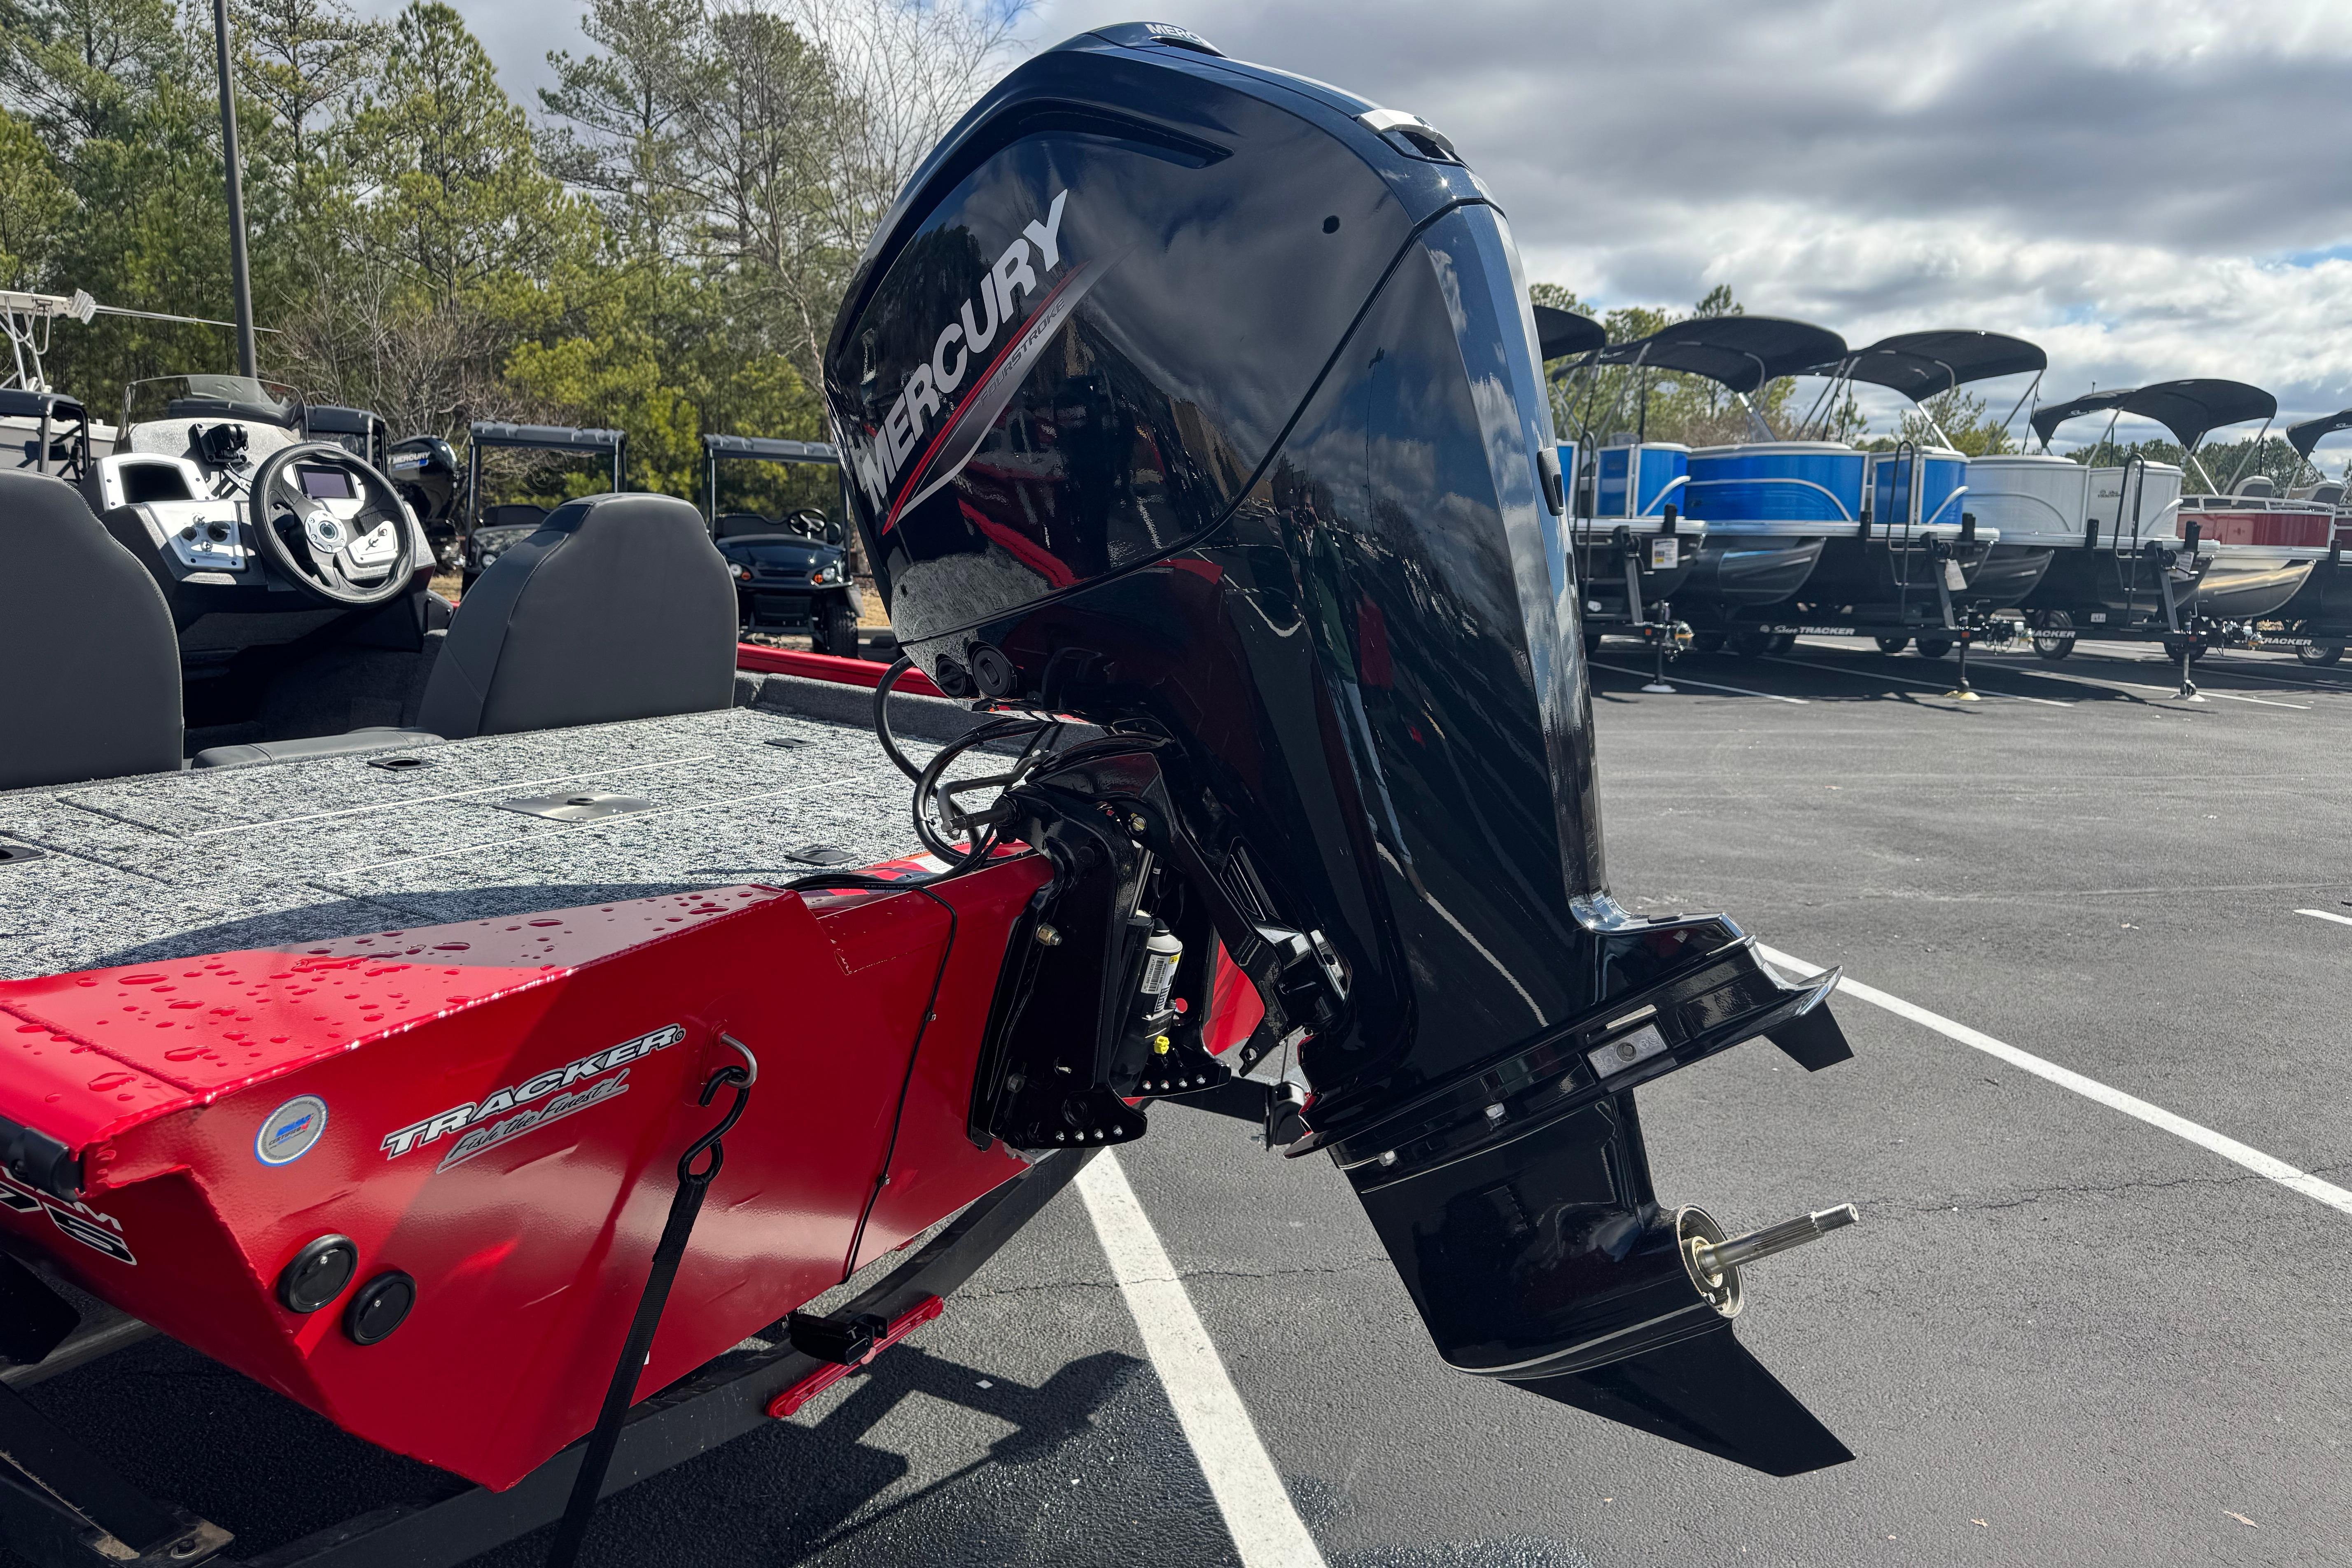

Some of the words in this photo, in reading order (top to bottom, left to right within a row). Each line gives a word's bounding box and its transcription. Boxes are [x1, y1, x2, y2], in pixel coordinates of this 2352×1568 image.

[1145, 23, 1205, 44] MERC
[862, 188, 1068, 516] MERCURY
[979, 296, 1065, 406] FOURSTROKE
[392, 451, 431, 464] MERCURY
[1798, 626, 1855, 635] TRACKER
[2032, 630, 2076, 638] ACKER
[450, 1122, 499, 1159] Fish
[503, 1113, 536, 1135] the
